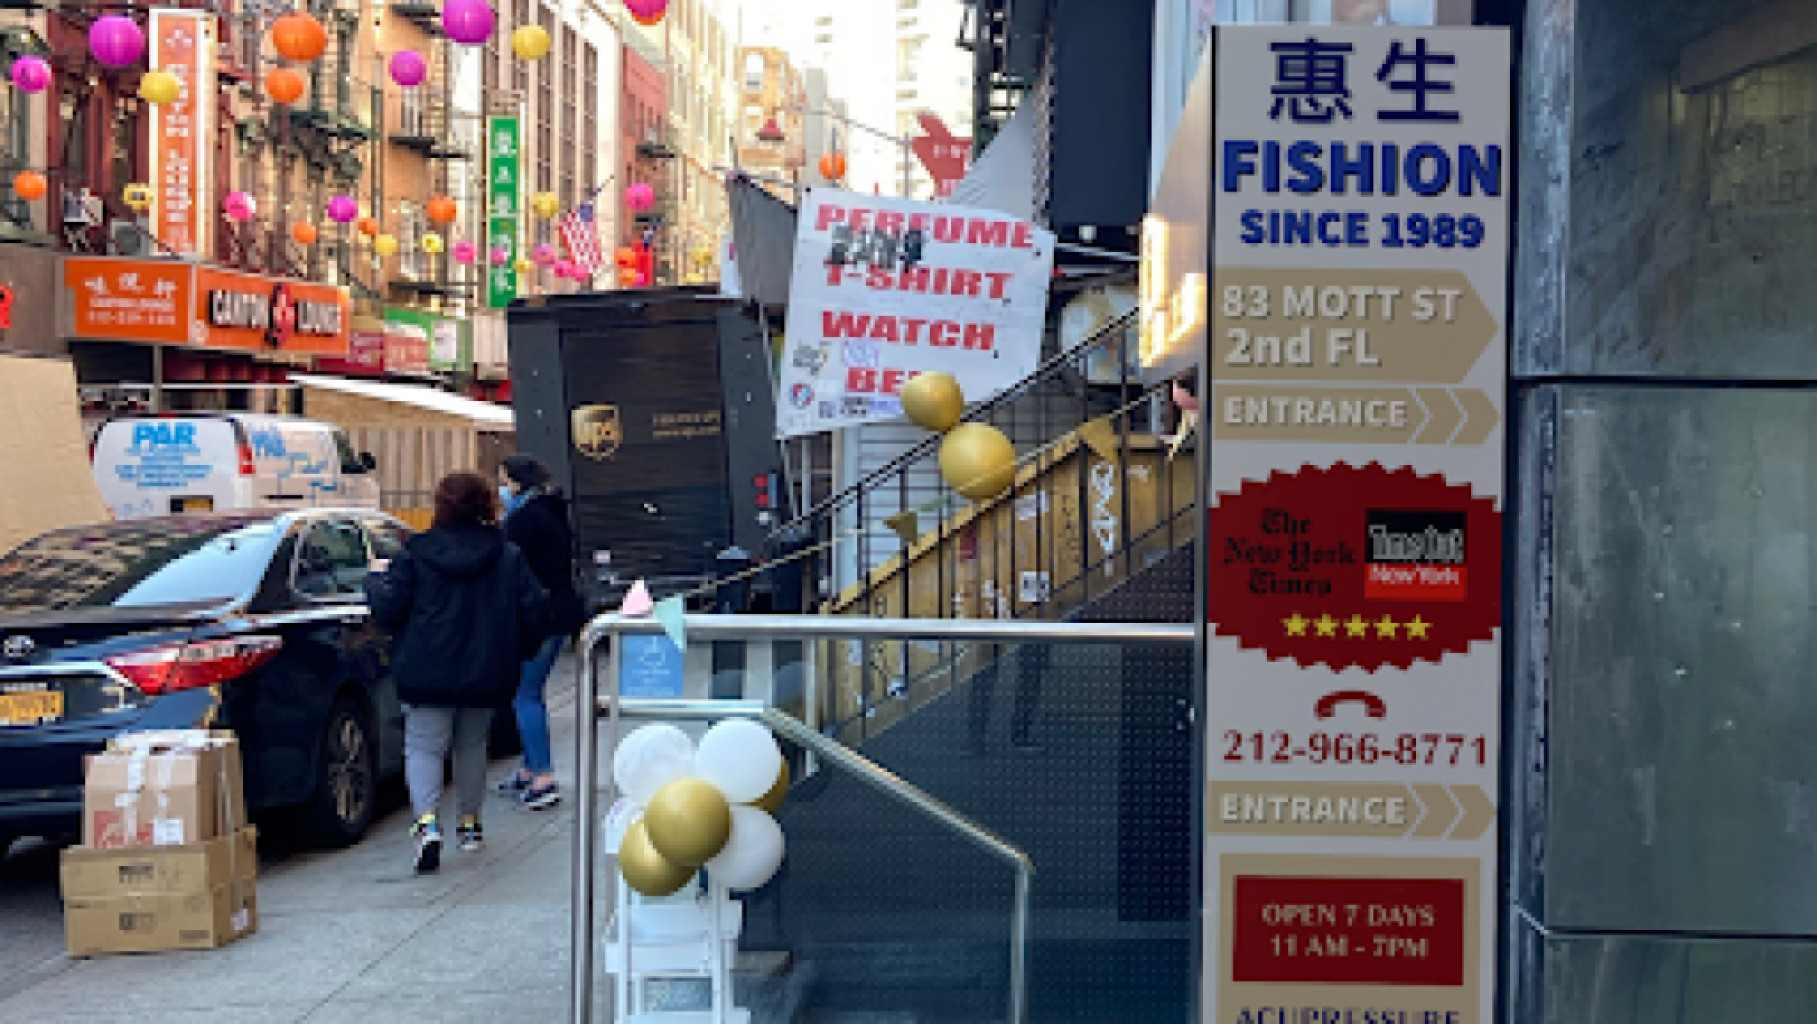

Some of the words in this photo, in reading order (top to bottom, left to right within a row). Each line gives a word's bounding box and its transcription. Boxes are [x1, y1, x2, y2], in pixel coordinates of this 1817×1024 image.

[1268, 37, 1461, 123] 惠生
[1222, 140, 1502, 197] FISHION
[1239, 209, 1369, 246] SINCE
[1381, 212, 1485, 248] 1989
[1222, 285, 1271, 320] 83
[1282, 285, 1401, 320] MOTT
[1411, 286, 1464, 324] ST
[1224, 326, 1313, 367] 2nd
[1327, 328, 1382, 367] FL
[1223, 397, 1408, 428] ENTRANCE
[132, 422, 197, 445] PAR
[1260, 507, 1312, 536] The
[1222, 729, 1487, 768] 212-966-8771
[1220, 793, 1407, 825] ENTRANCE
[1261, 903, 1337, 927] OPEN
[1343, 904, 1362, 927] 7
[1368, 904, 1435, 928] DAYS
[1271, 934, 1298, 957] 11
[1304, 934, 1349, 957] AM
[1372, 934, 1429, 958] 7PM
